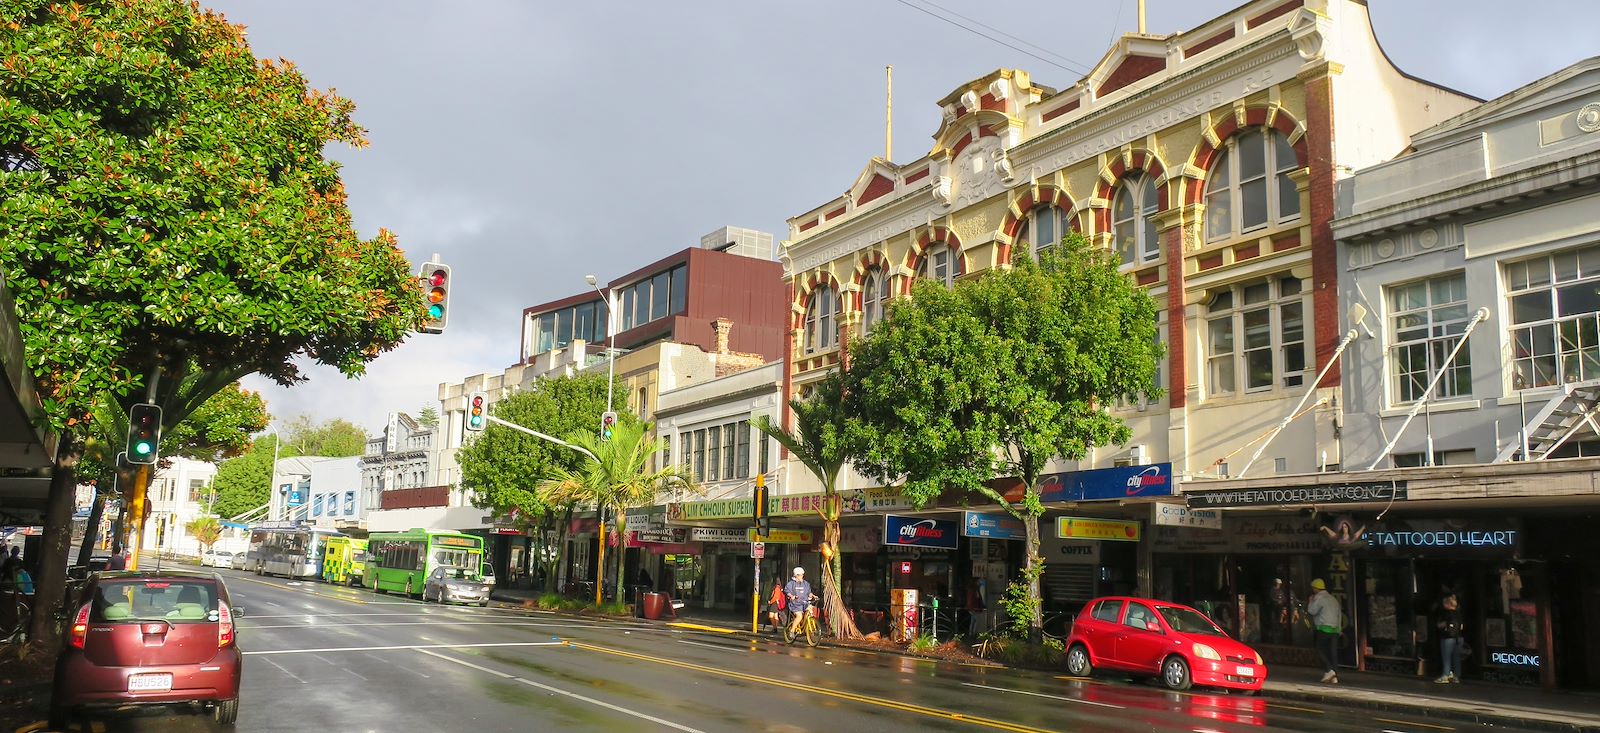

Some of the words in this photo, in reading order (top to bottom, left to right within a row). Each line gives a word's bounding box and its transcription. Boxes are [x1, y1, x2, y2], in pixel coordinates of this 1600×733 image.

[1051, 90, 1222, 164] KARANGAHAPE
[687, 504, 698, 517] LIM
[699, 502, 726, 517] CHHOUR
[728, 498, 780, 515] SUPERMET
[1376, 531, 1457, 546] TATTOOED
[1460, 530, 1516, 546] HEART
[1492, 652, 1540, 666] PIERCING
